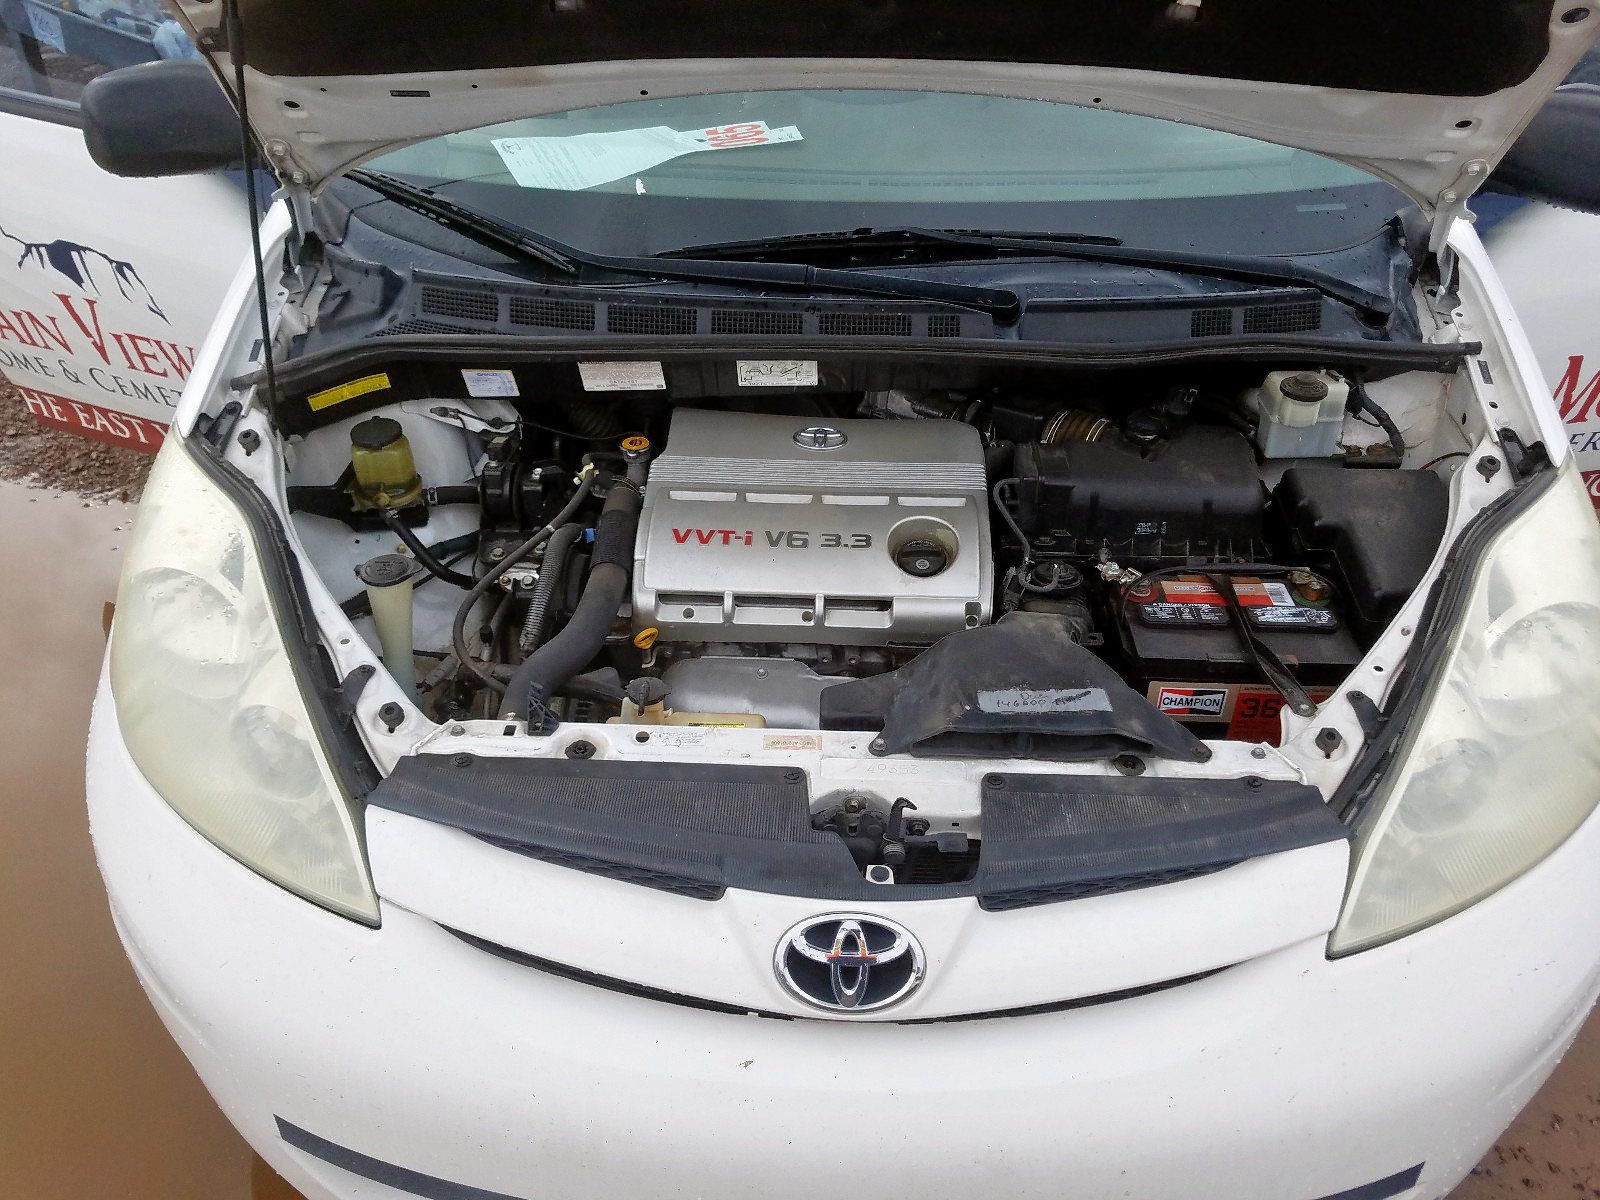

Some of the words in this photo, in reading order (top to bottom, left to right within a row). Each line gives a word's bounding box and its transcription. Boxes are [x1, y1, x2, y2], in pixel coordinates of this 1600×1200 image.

[52, 290, 195, 382] VIEW
[58, 359, 87, 385] &
[69, 402, 149, 443] EAST
[672, 528, 753, 547] VVT-i
[765, 530, 809, 548] V6
[820, 533, 872, 549] 3.3
[1162, 696, 1222, 708] CHAMPION
